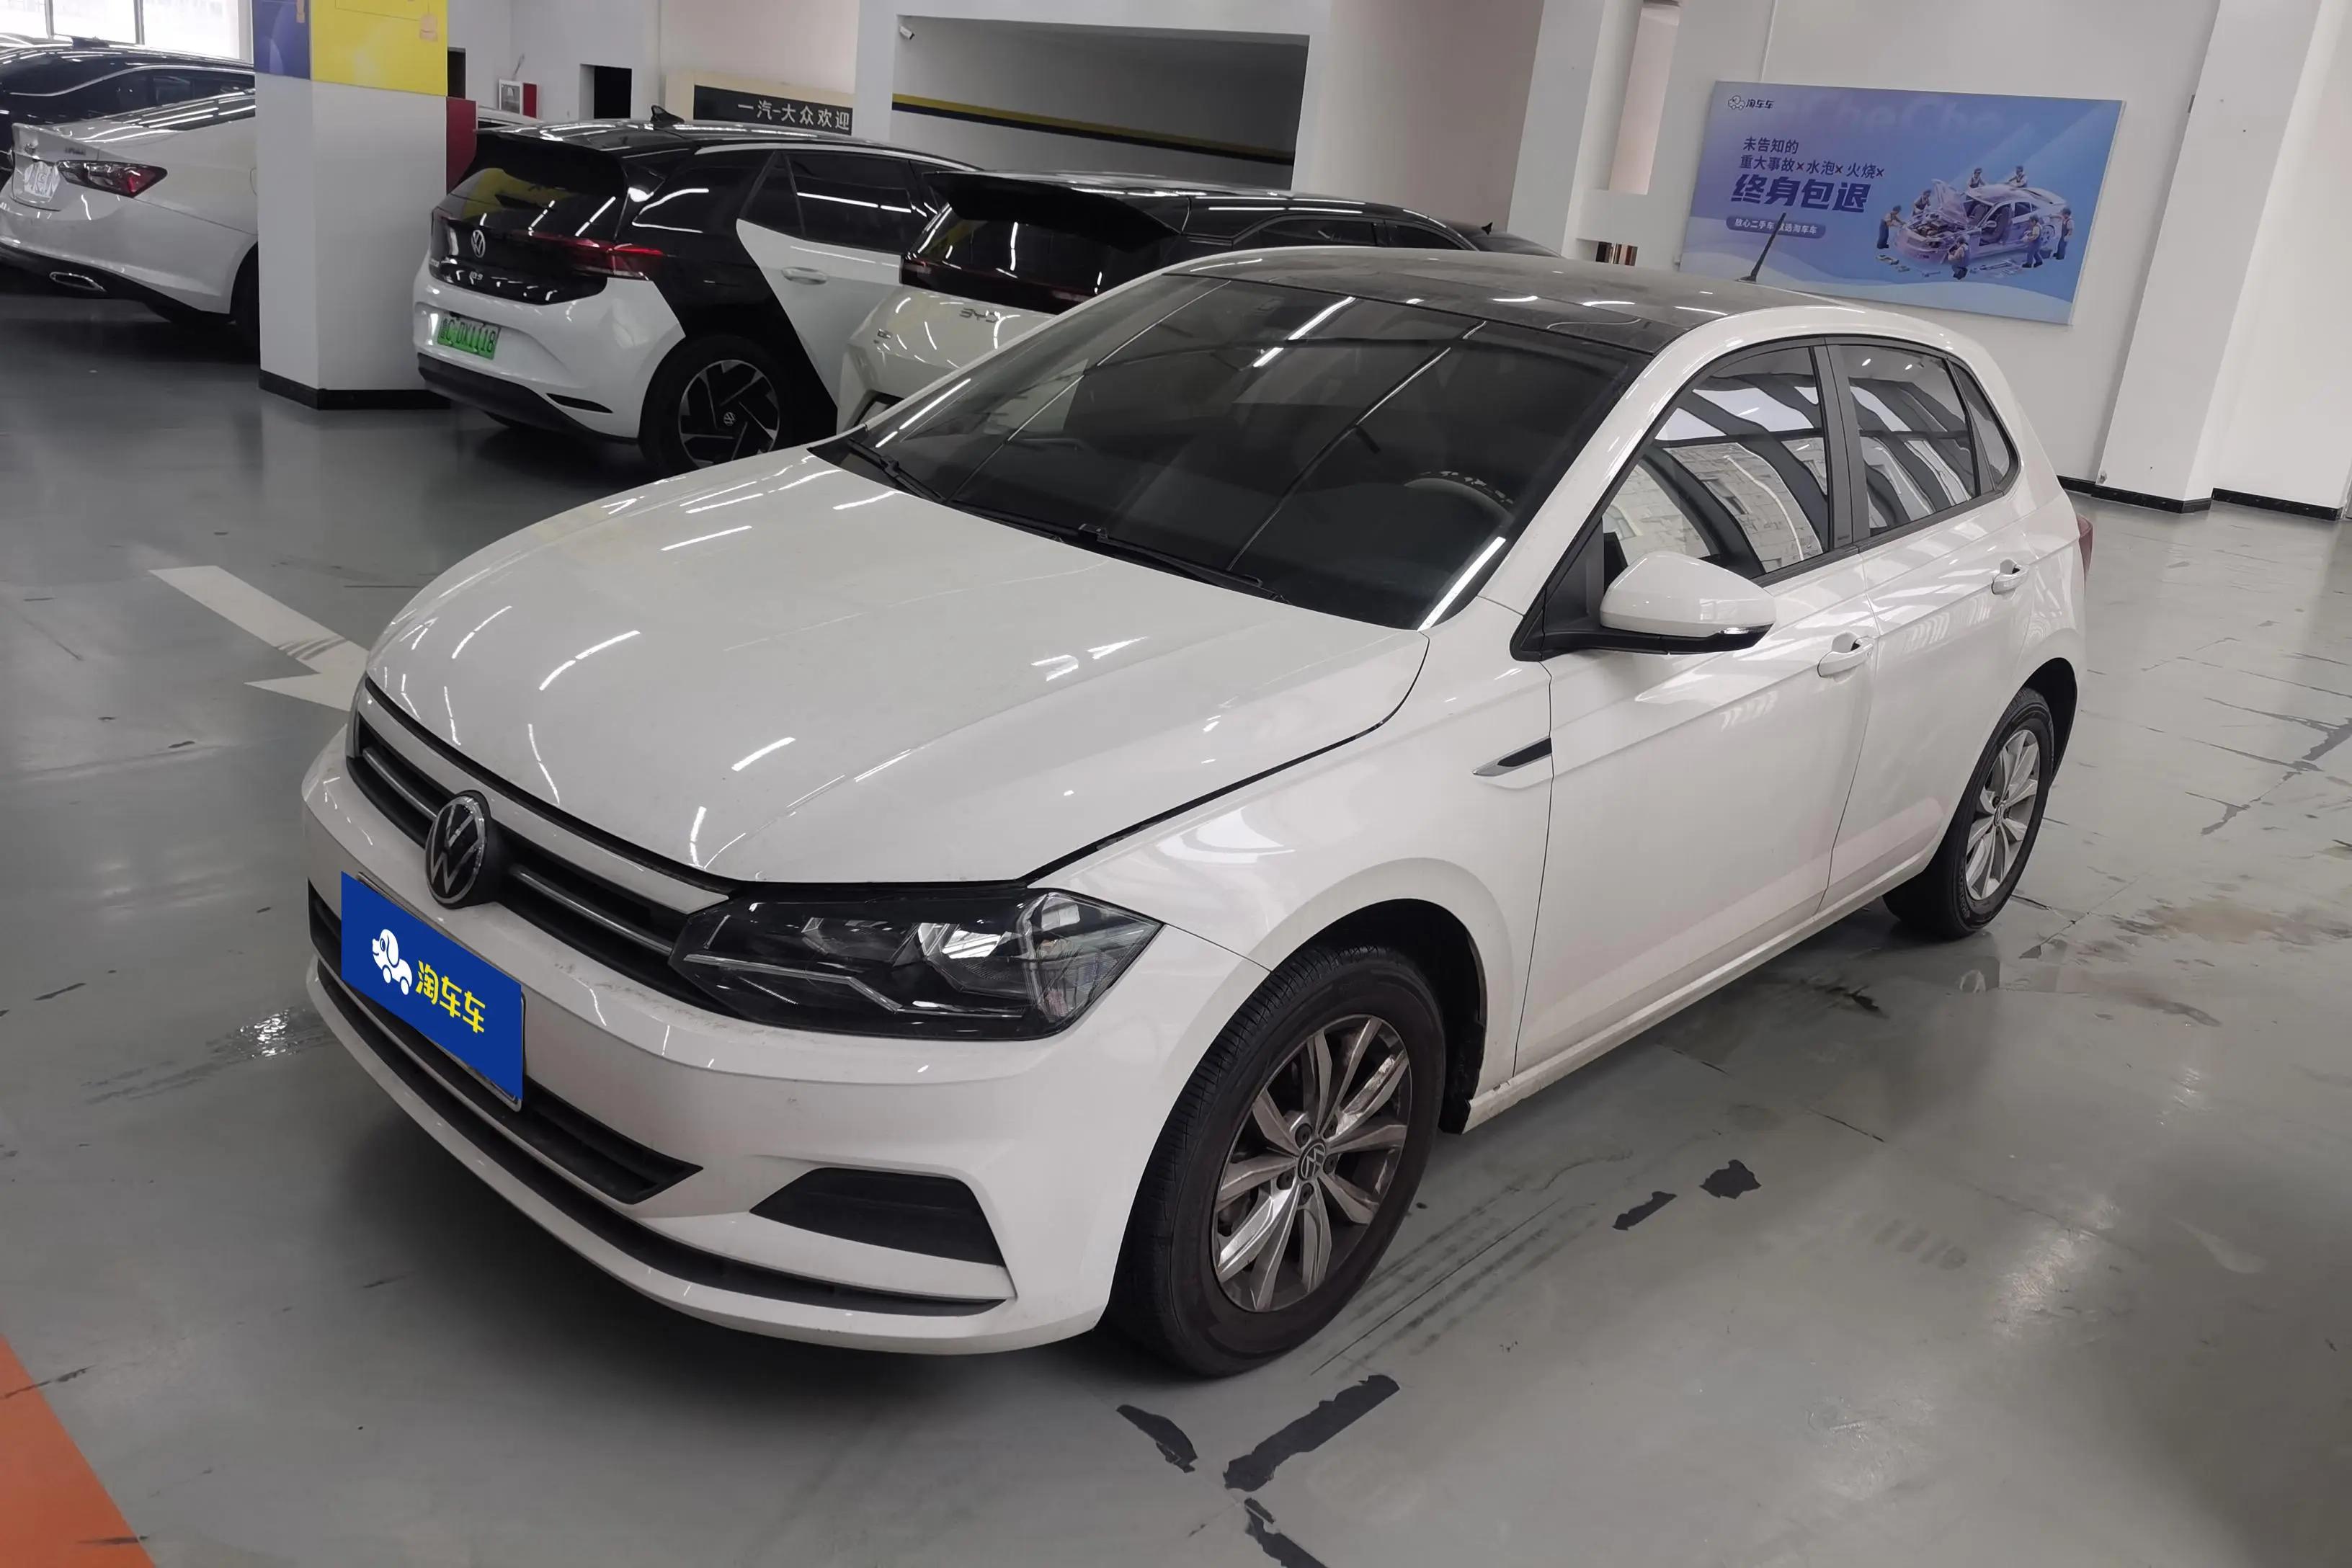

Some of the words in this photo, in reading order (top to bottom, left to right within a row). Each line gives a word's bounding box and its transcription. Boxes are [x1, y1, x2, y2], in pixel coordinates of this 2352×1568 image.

[738, 100, 850, 130] 一汽-大众欢迎
[1745, 99, 1775, 110] 淘车车
[1742, 137, 1799, 154] 未告知的
[1731, 174, 1871, 213] 终身包退
